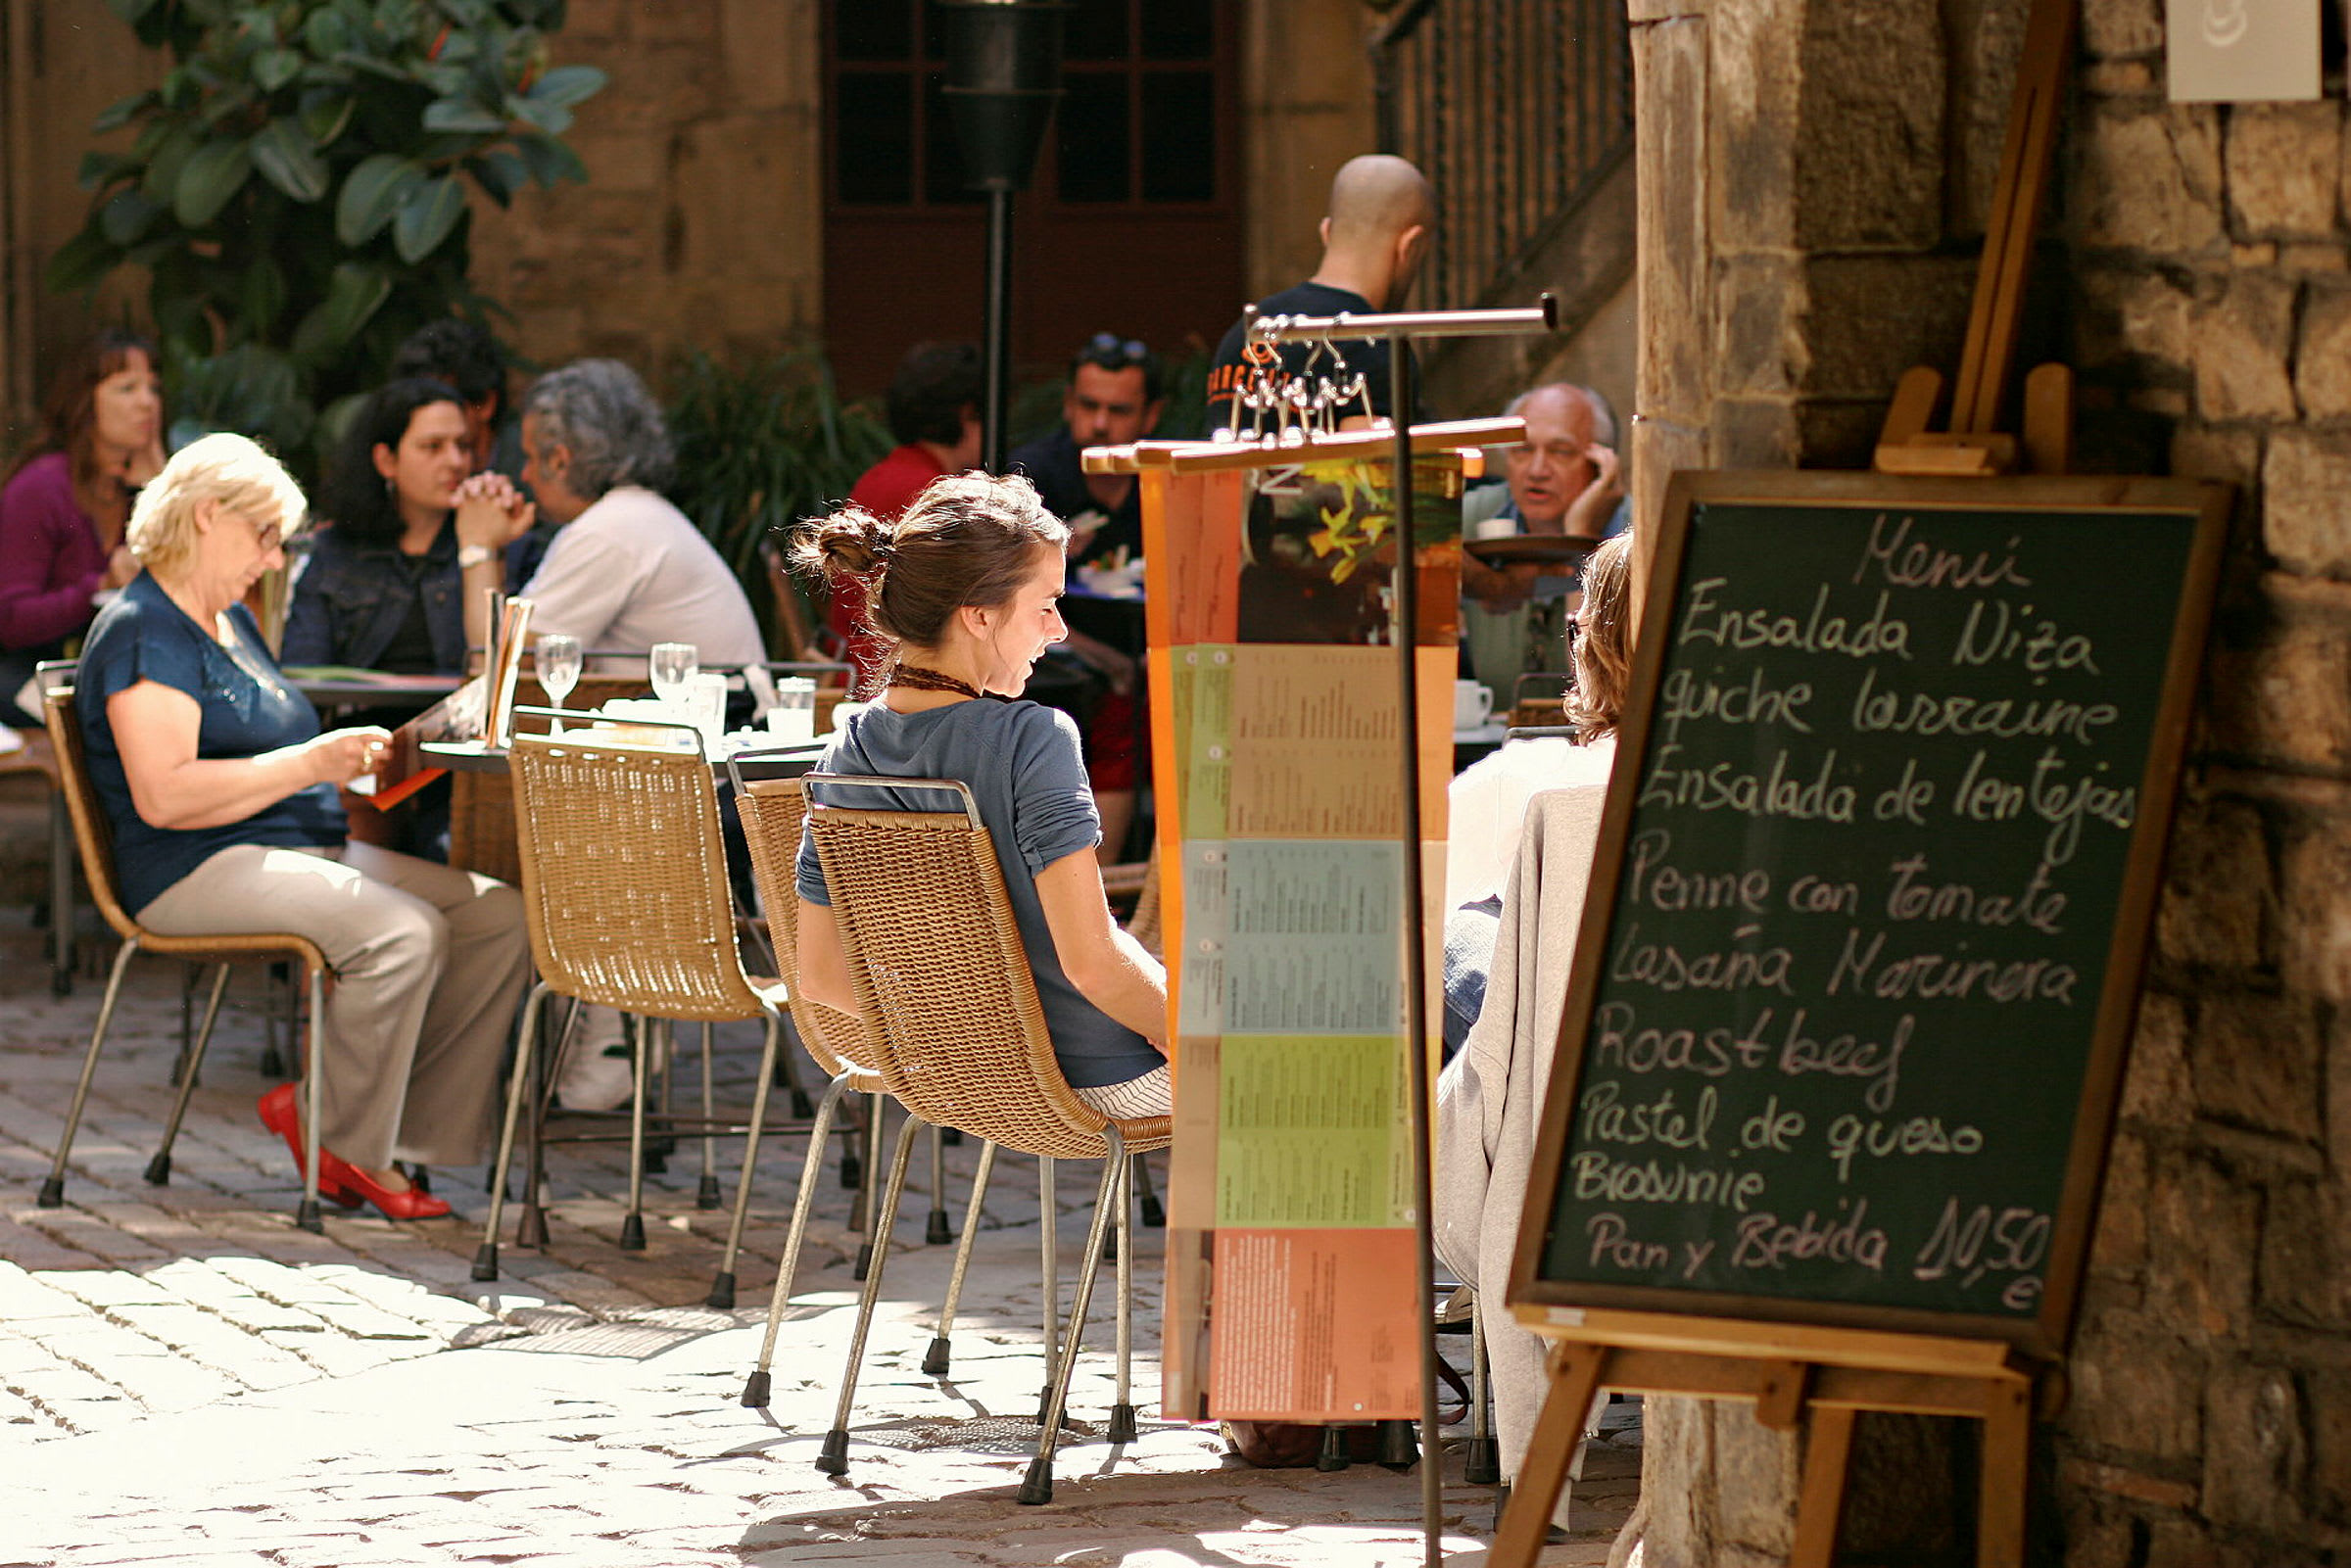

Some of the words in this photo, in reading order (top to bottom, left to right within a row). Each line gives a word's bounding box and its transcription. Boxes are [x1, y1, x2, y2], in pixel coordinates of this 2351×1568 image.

[1678, 578, 1913, 660] Ensalada
[1638, 744, 1855, 824] Ensalada
[1874, 758, 1935, 826] de
[1953, 746, 2136, 865] lentejas
[1630, 829, 1770, 913] Penne
[1788, 875, 1859, 916] con
[1612, 923, 1795, 996] Lasaña
[1827, 927, 2079, 1006] Marinera
[1581, 1080, 1718, 1151] Pastel
[1741, 1094, 1806, 1153] de
[1828, 1113, 1985, 1183] queso
[1571, 1150, 1765, 1212] Brownie
[1586, 1212, 1670, 1268] Pan
[1683, 1239, 1716, 1280] y
[1732, 1197, 1890, 1270] Bebida
[1914, 1196, 2051, 1289] 10,50
